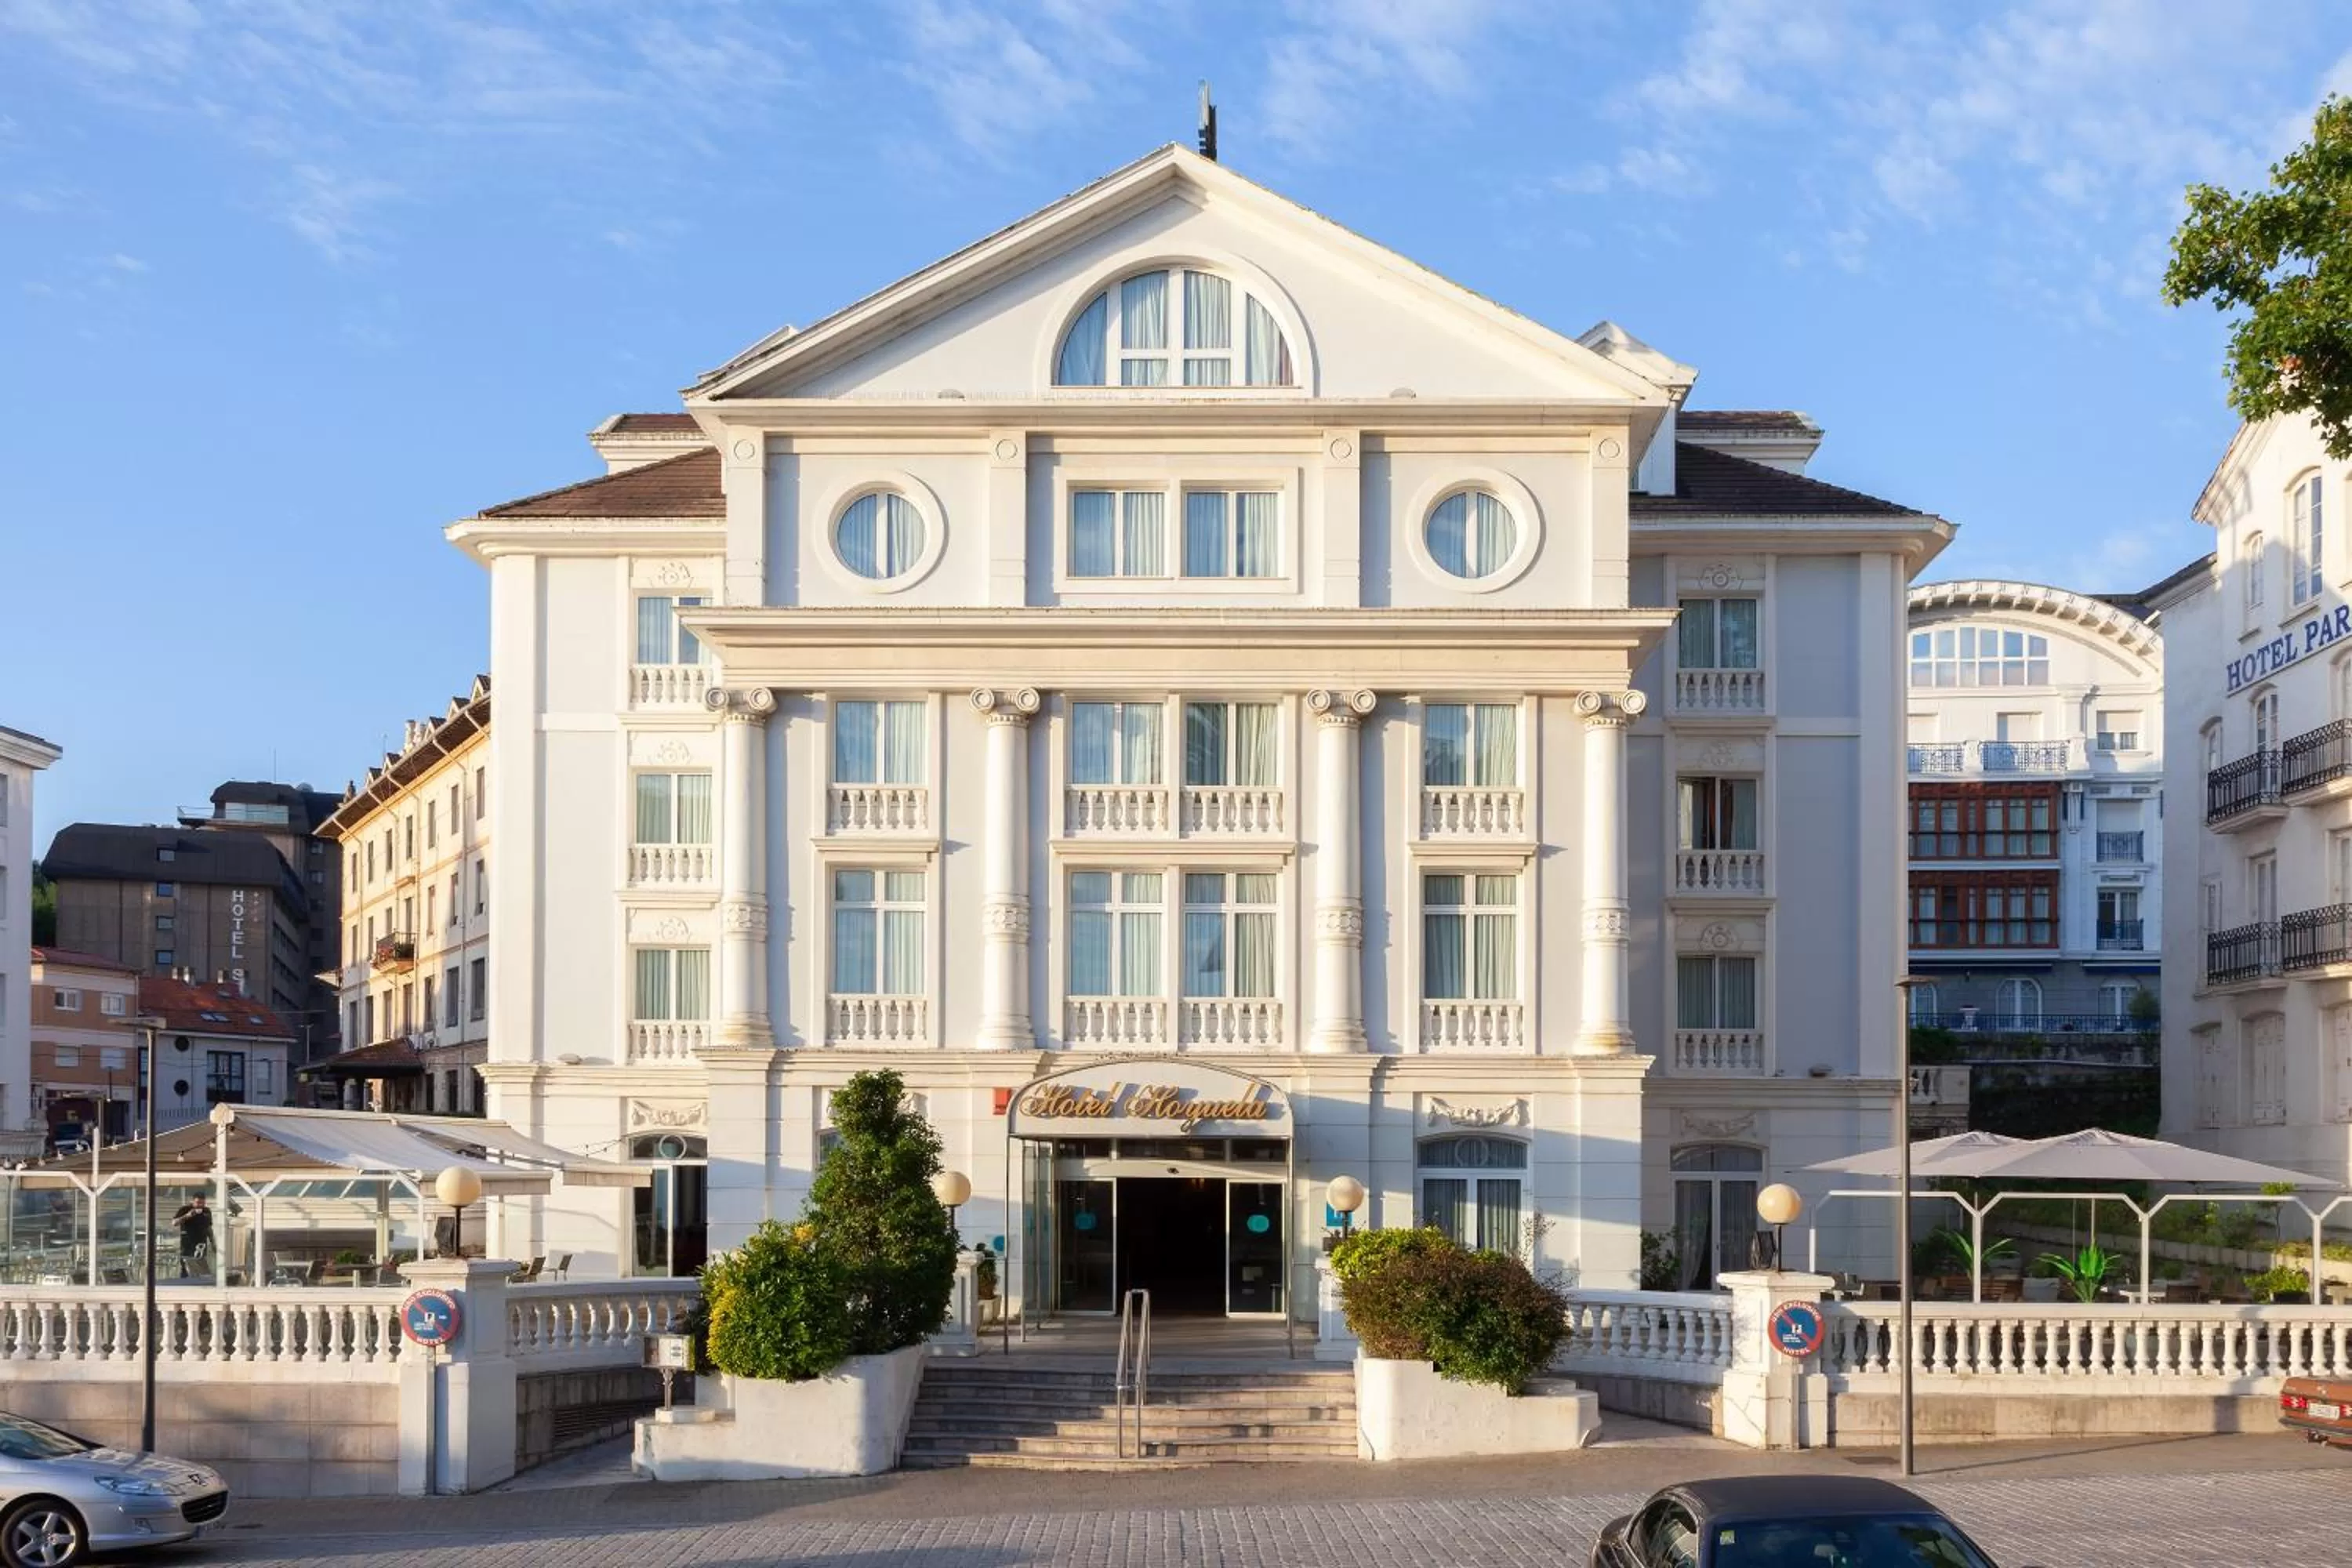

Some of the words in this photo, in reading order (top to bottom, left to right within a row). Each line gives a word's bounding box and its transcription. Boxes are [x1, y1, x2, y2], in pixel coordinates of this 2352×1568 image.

[2226, 633, 2298, 691] HOTEL
[2304, 604, 2352, 653] PAR
[231, 891, 245, 959] HOTEL
[1019, 1082, 1121, 1116] Hotel
[1124, 1082, 1267, 1132] Hoyuela
[1783, 1346, 1811, 1355] HOTEL
